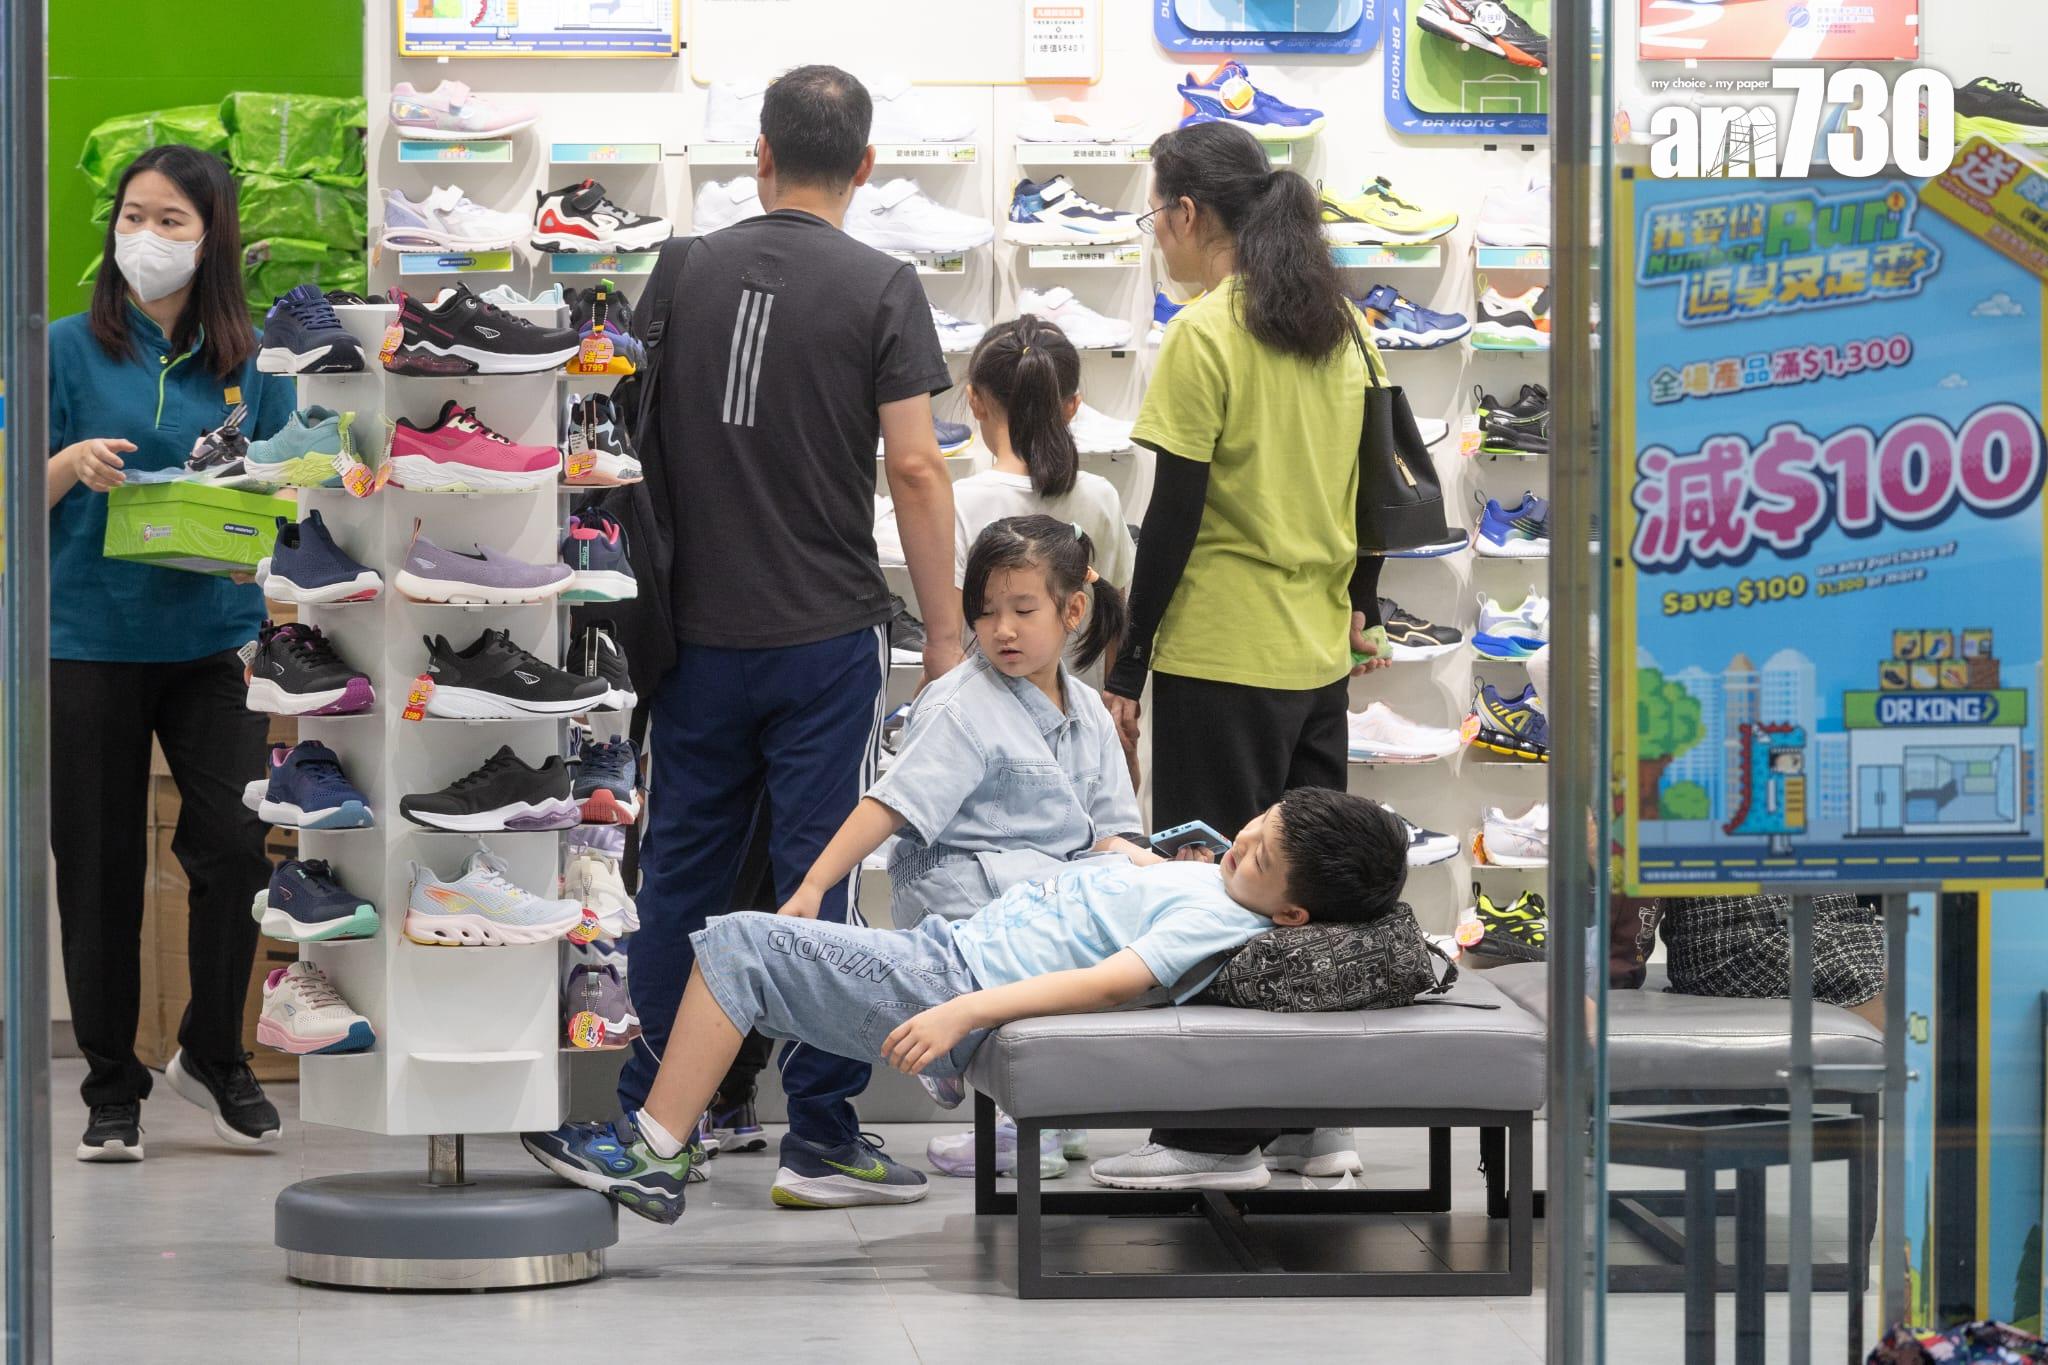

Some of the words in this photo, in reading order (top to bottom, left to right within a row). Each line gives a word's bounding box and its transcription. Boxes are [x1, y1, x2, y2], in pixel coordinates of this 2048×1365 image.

[1950, 145, 2020, 196] 送
[1653, 337, 1908, 400] 全場產品滿$1,300
[1637, 405, 2037, 561] 減$100
[1838, 559, 1866, 573] any
[1866, 547, 1936, 570] purchase
[1884, 568, 1927, 584] more
[1662, 586, 1732, 616] Save
[1737, 573, 1807, 608] $100
